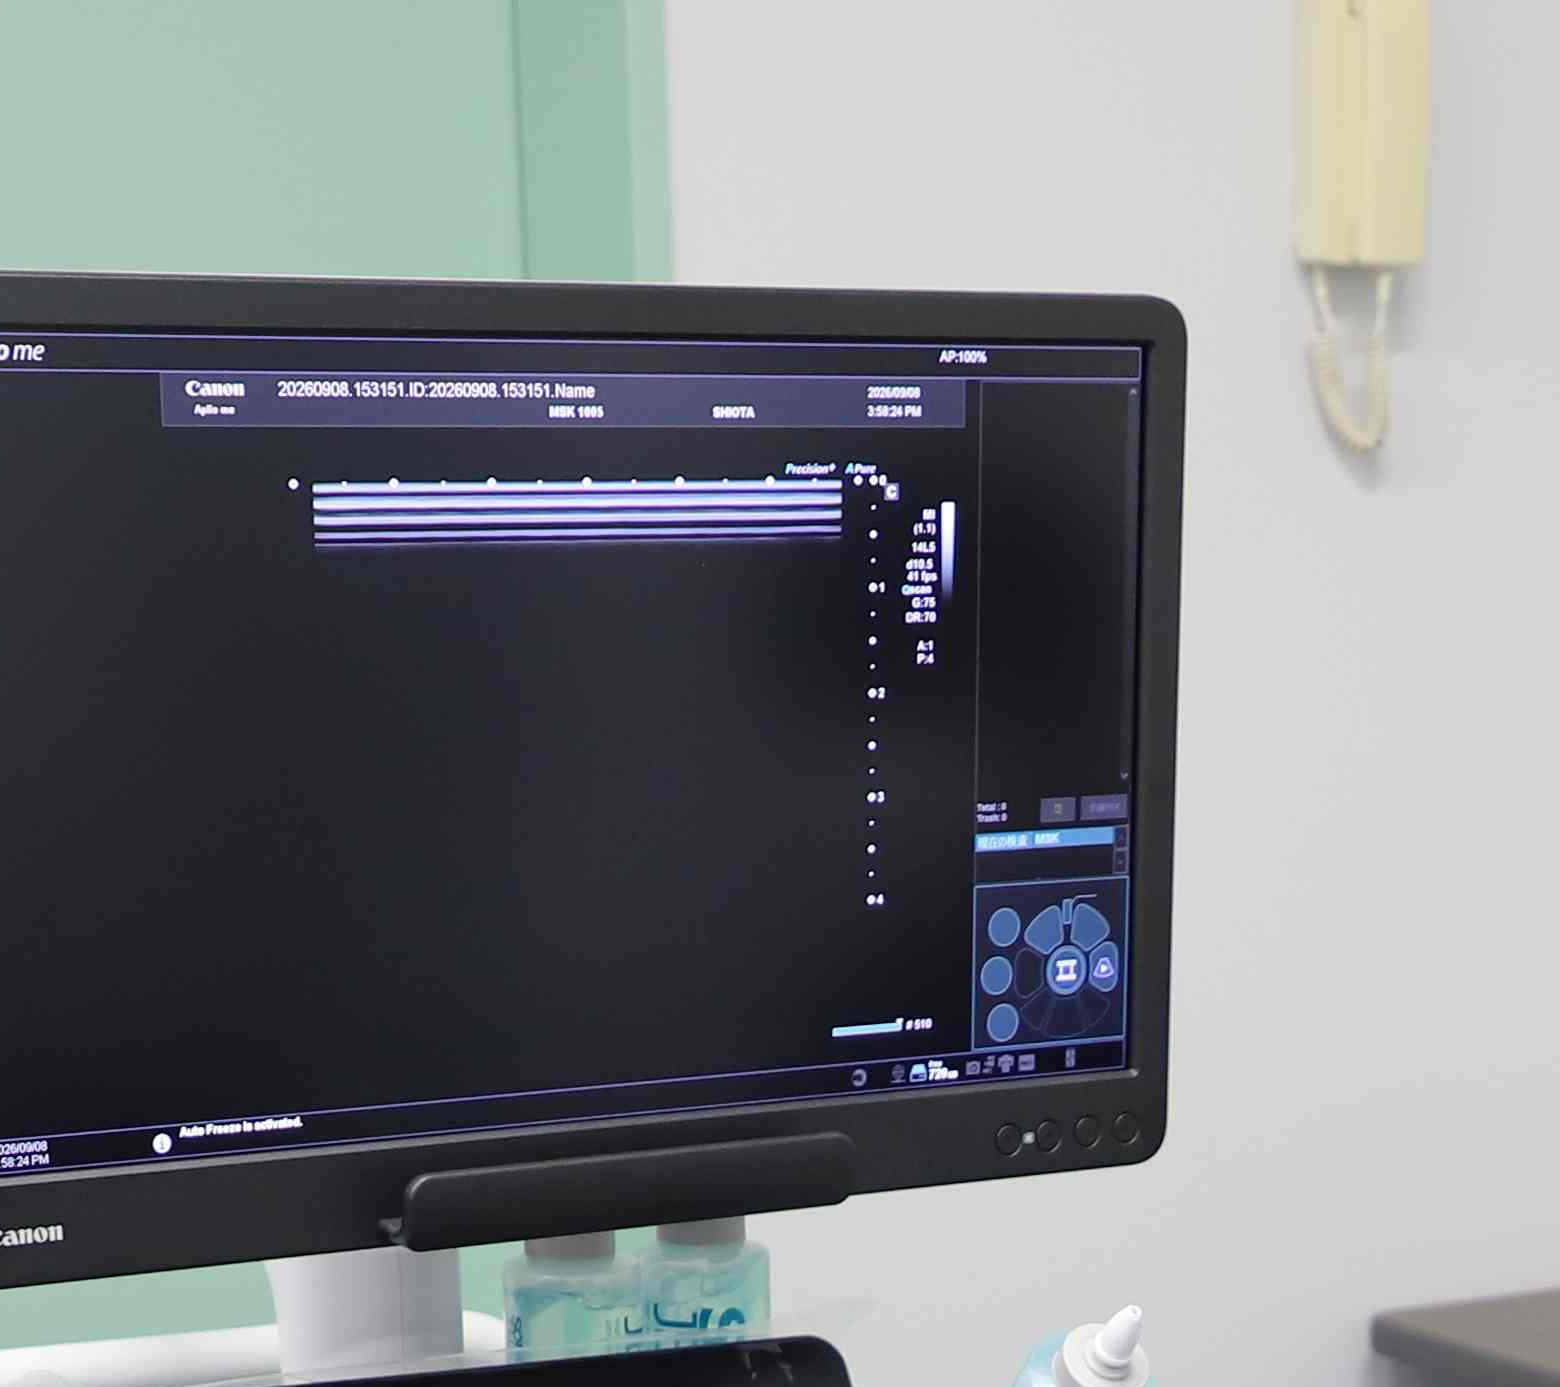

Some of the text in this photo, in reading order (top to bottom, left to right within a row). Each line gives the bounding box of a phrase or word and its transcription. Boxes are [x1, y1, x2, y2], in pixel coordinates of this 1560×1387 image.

[12, 343, 46, 361] me
[939, 350, 987, 364] AP:100%
[185, 380, 245, 397] Canon
[179, 1125, 204, 1138] Auto
[206, 1121, 241, 1136] Freeze
[254, 1116, 303, 1131] activated.
[31, 1153, 50, 1166] PM
